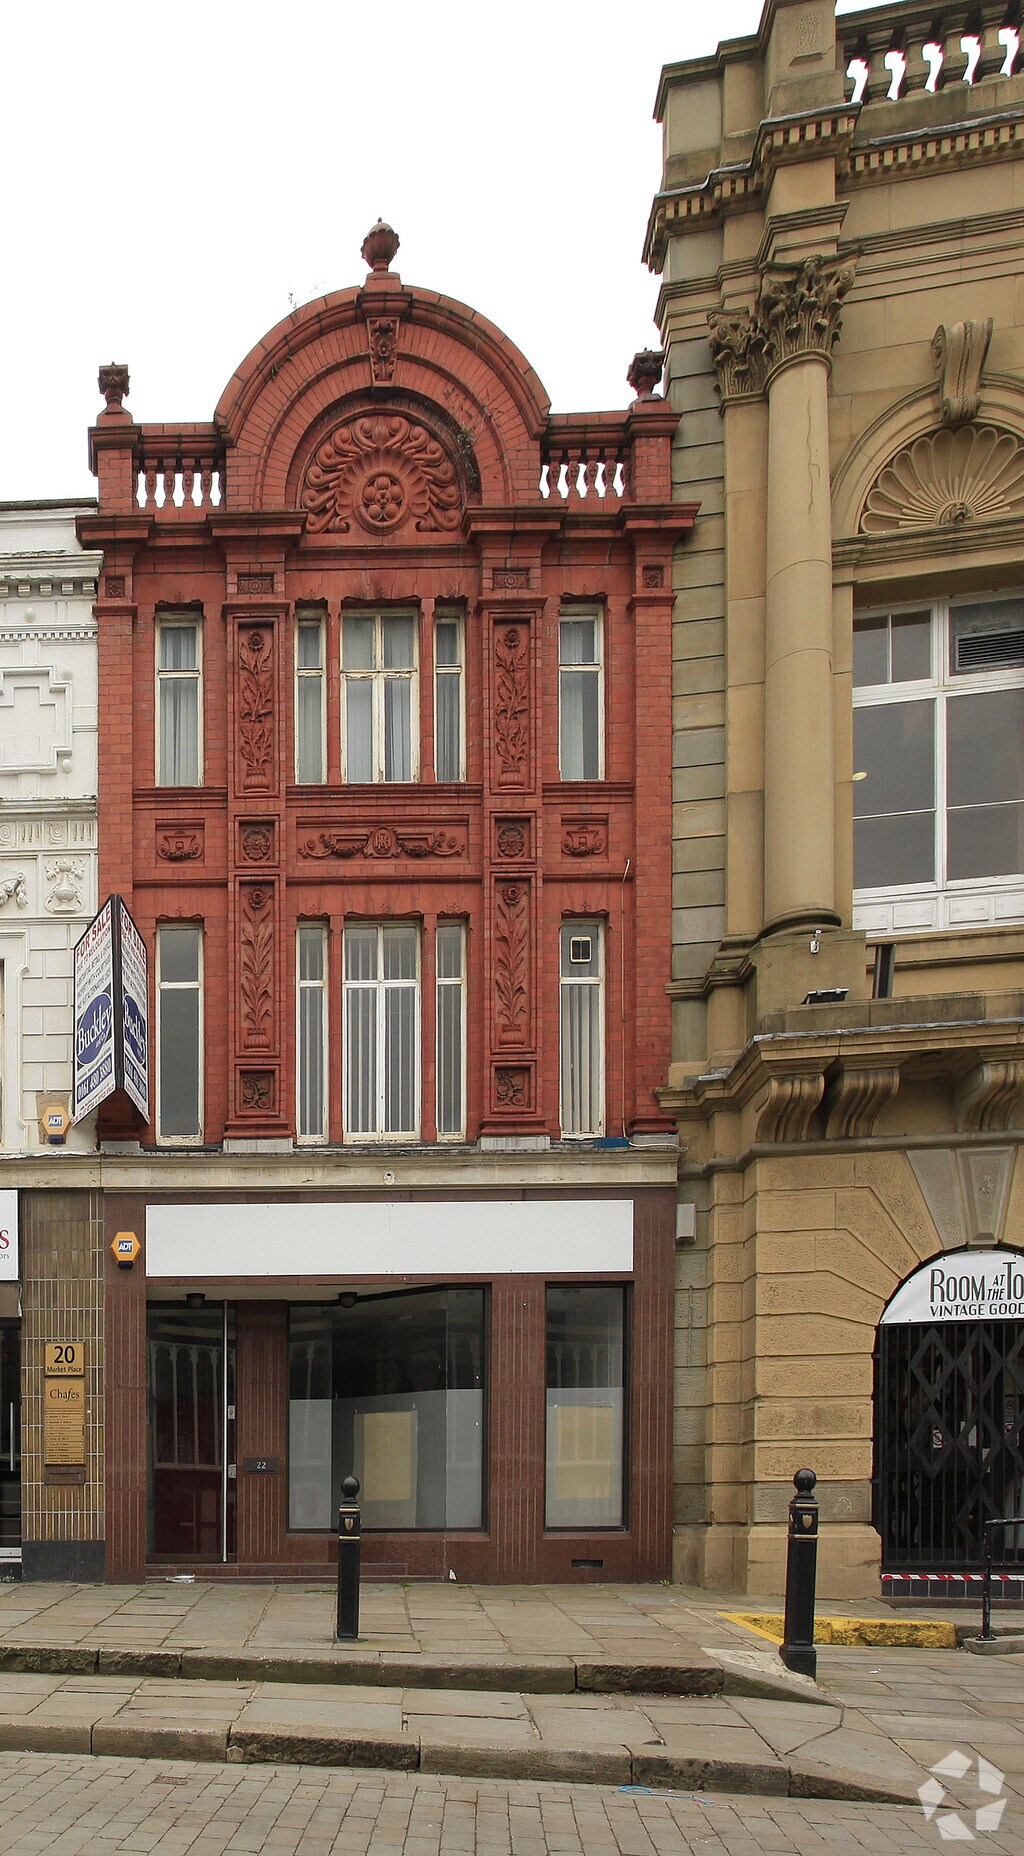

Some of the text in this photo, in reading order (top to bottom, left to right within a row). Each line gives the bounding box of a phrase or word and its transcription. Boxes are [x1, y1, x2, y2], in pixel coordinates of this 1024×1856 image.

[77, 904, 111, 964] FOR SALE
[78, 1004, 112, 1056] Buckley
[48, 1116, 63, 1125] ADT
[118, 1242, 133, 1251] ADT
[930, 1268, 985, 1302] ROOM
[993, 1274, 1005, 1286] AT
[987, 1288, 1005, 1300] THE
[930, 1303, 985, 1317] VINTAGE
[54, 1345, 75, 1363] 20
[49, 1388, 80, 1402] Chafes
[256, 1461, 267, 1469] 22
